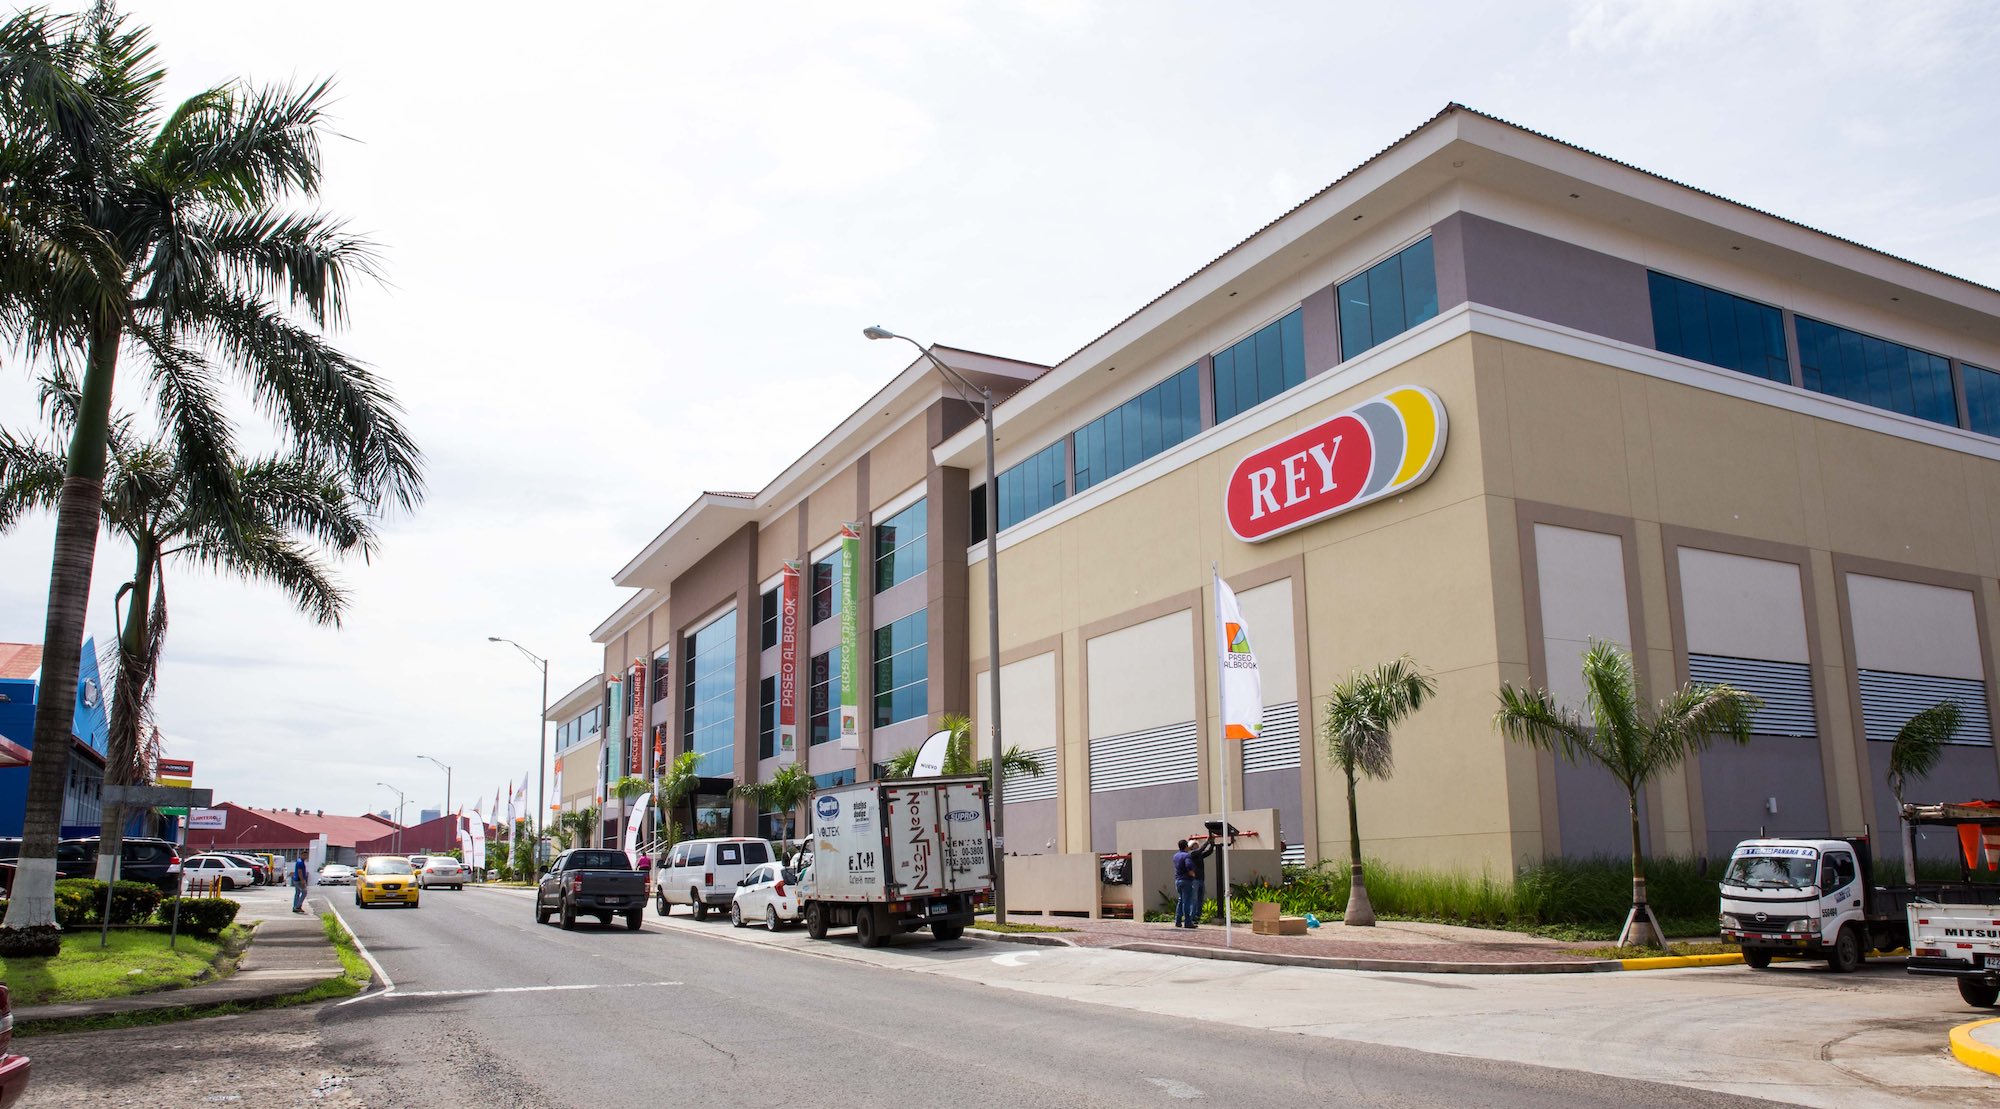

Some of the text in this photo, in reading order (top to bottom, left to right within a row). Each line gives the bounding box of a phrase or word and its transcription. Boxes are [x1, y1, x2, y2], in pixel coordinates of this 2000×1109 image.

[1247, 434, 1343, 521] REY
[842, 551, 852, 692] KIOSKOS DISPONIBLES
[782, 598, 796, 707] PASEO ALBROOK
[1223, 654, 1258, 670] PASEO ALBROOK
[633, 671, 642, 725] VEHICULARES
[950, 811, 975, 821] SUPRO
[1945, 928, 2000, 938] MITSU
